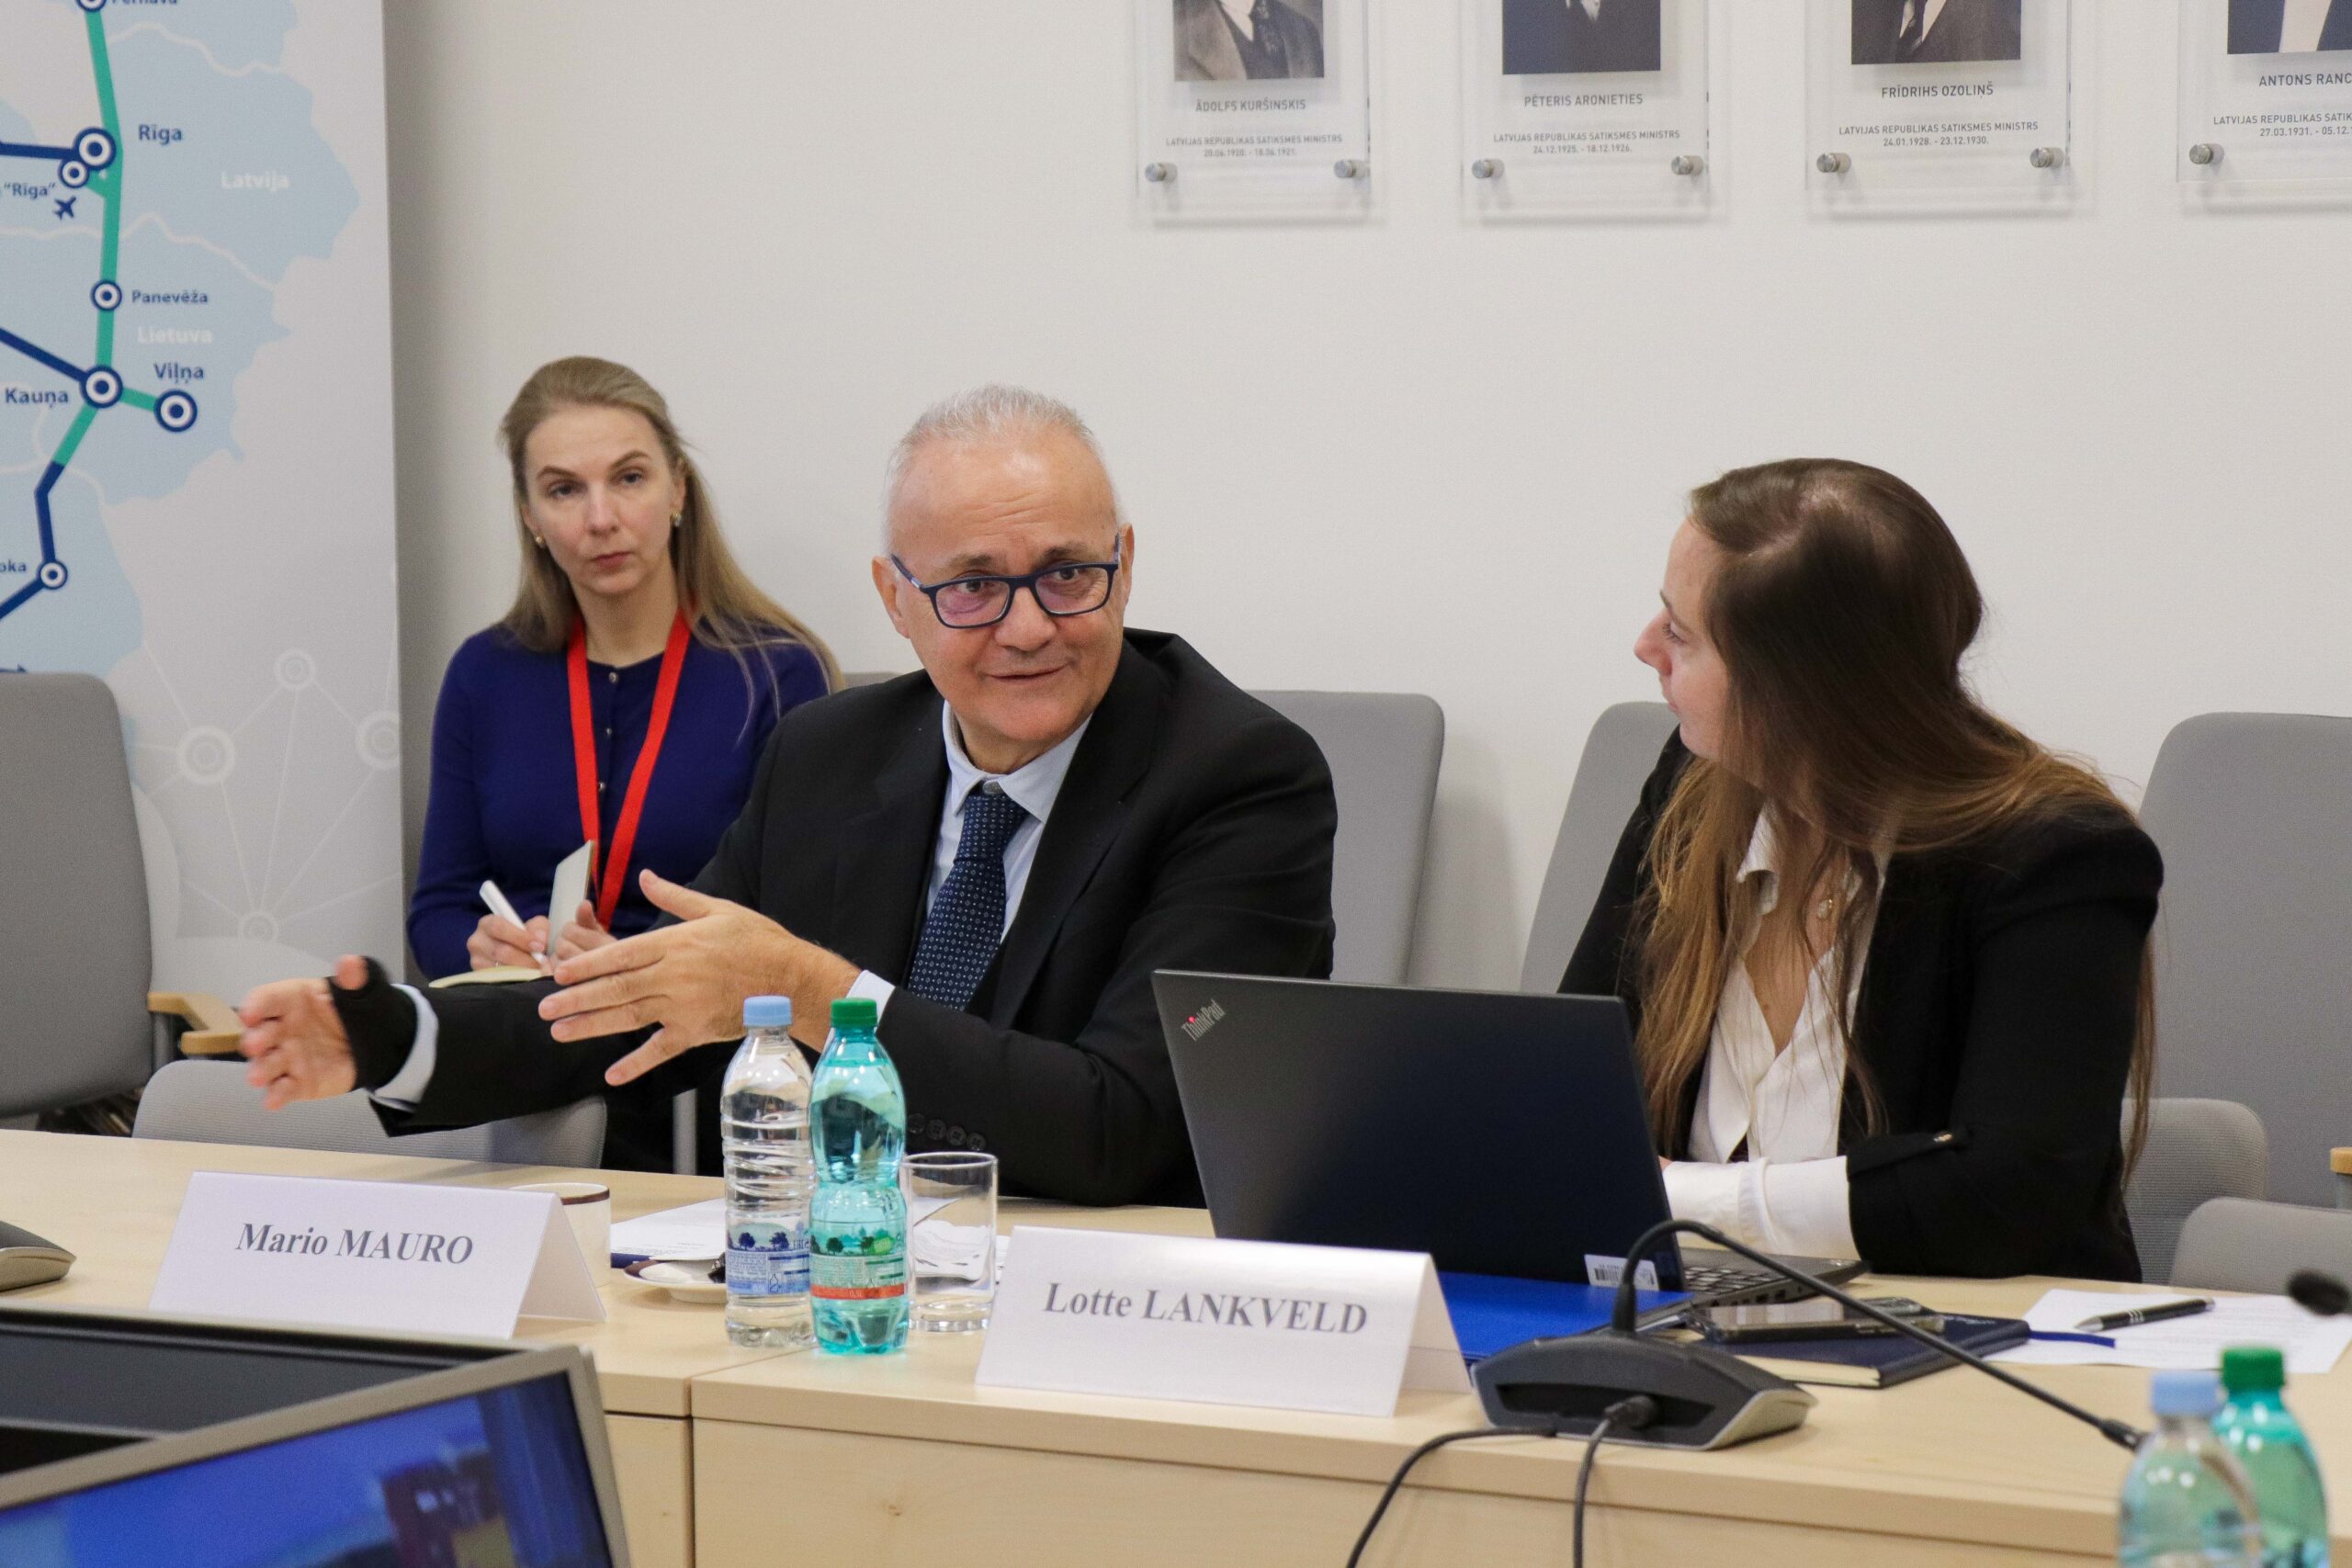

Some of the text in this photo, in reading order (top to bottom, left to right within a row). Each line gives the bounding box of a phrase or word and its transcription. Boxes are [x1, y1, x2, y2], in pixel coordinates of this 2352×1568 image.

[2259, 73, 2352, 86] ANTONS RANC
[1882, 81, 1994, 98] FRĪDRIHS OZOLIŅŠ
[1195, 97, 1306, 112] ĀDOLFS KURŠINSKIS
[1524, 93, 1644, 107] PĒTERIS ARONIETIES
[2213, 112, 2352, 125] LATVIJAS REPUBLIKAS SATIK
[139, 124, 183, 146] Rīga
[1838, 120, 2039, 135] LATVIJAS REPUBLIKAS SATIKSMES MINISTRS
[2259, 127, 2312, 137] 27.03.1931.
[2322, 125, 2352, 136] 05.12.
[1166, 134, 1343, 147] LATVIJAS REPUBLIKAS SATIKSMES MINISTRS
[1493, 130, 1680, 142] LATVIJAS REPUBLIKAS SATIKSMES MINISTRS
[1883, 137, 1932, 147] 24.01.1928.
[1940, 135, 1989, 145] 23.12.1930.
[220, 172, 288, 191] Latvija
[131, 289, 209, 303] Panevēža
[138, 327, 212, 344] Lietuva
[153, 363, 204, 383] Viļņa
[6, 388, 68, 408] Kauņa
[1181, 998, 1226, 1041] ThinkPad
[235, 1223, 473, 1264] Mario MAURO
[1043, 1282, 1368, 1334] Lotte LANKVELD
